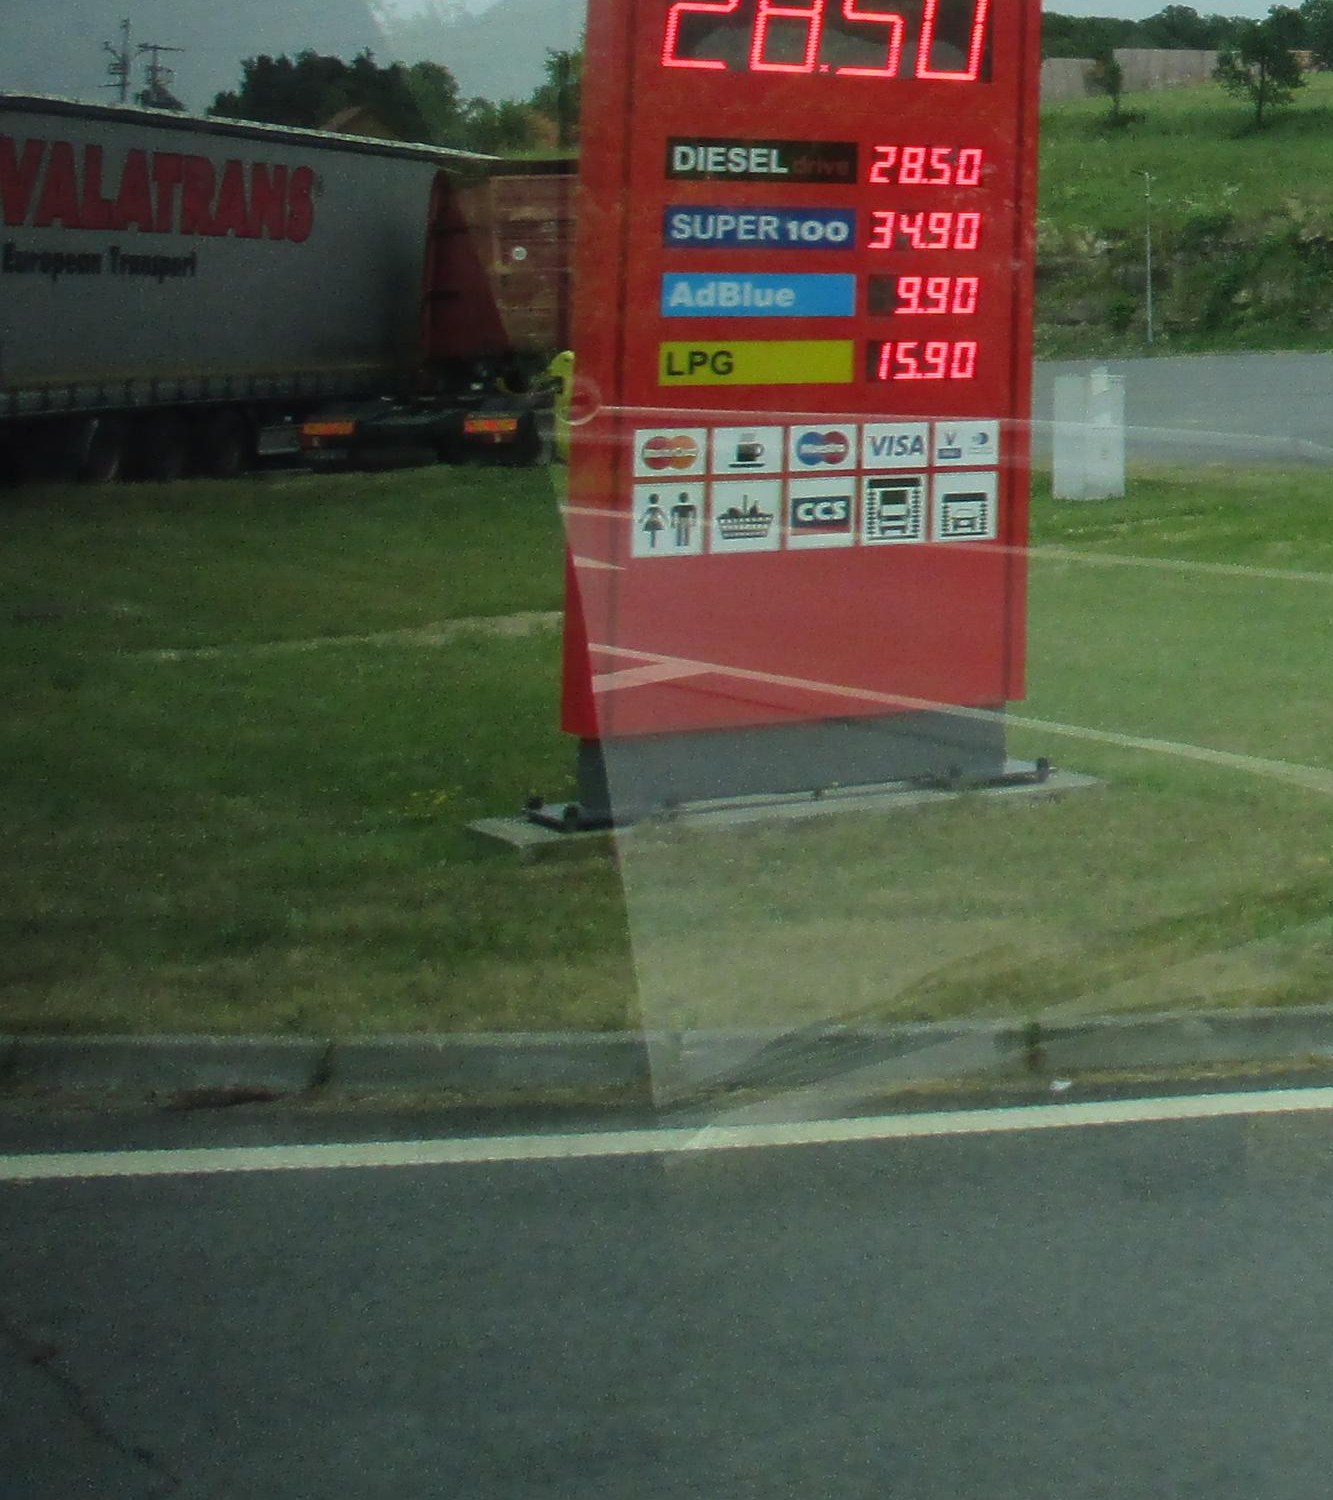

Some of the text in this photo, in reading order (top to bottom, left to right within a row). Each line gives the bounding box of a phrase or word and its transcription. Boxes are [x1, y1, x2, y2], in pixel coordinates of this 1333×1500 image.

[672, 145, 788, 175] DIESEL
[868, 146, 984, 186] 28.50
[0, 135, 316, 243] VALATRANS
[670, 214, 849, 242] SUPER 100
[866, 211, 981, 250] 34.90
[668, 281, 795, 307] AdBlue
[893, 276, 979, 315] 9.90
[667, 350, 734, 376] LPG
[877, 341, 977, 380] 15.90
[870, 434, 926, 458] VISA
[796, 500, 848, 522] CCS
